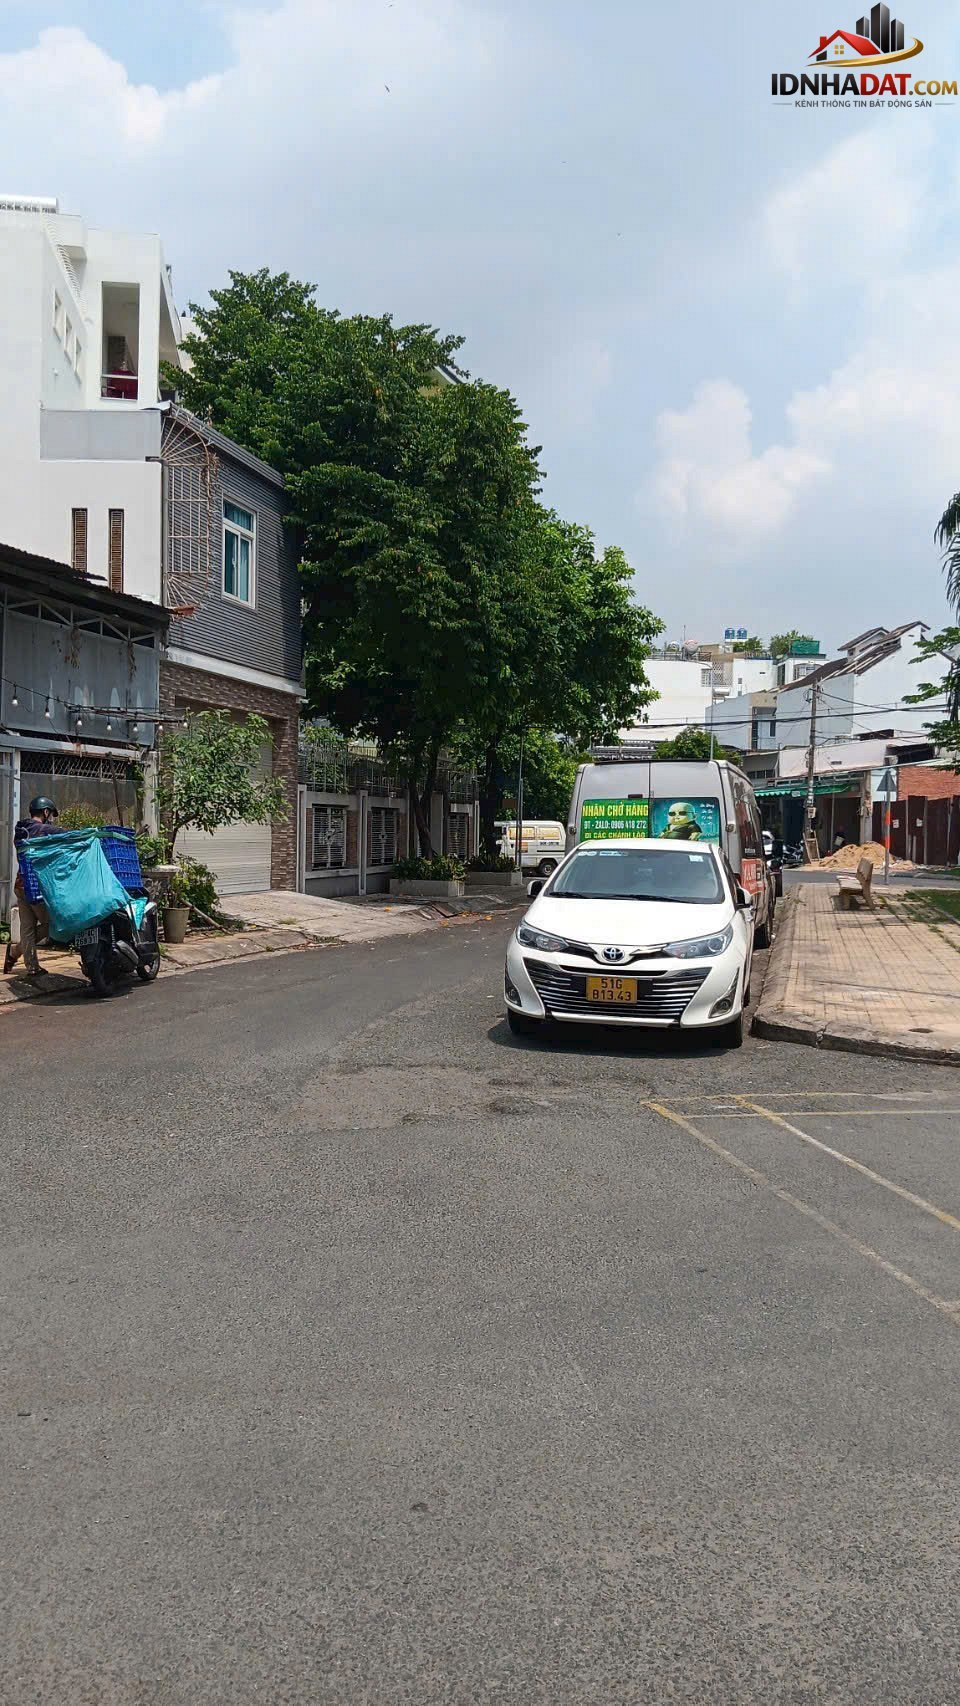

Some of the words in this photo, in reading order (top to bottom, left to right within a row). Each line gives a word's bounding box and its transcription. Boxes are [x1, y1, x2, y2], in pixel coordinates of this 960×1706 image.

[582, 803, 605, 819] NHẬN
[625, 802, 649, 817] HÀNG
[601, 978, 623, 989] 51G
[592, 989, 631, 1001] 813.43
